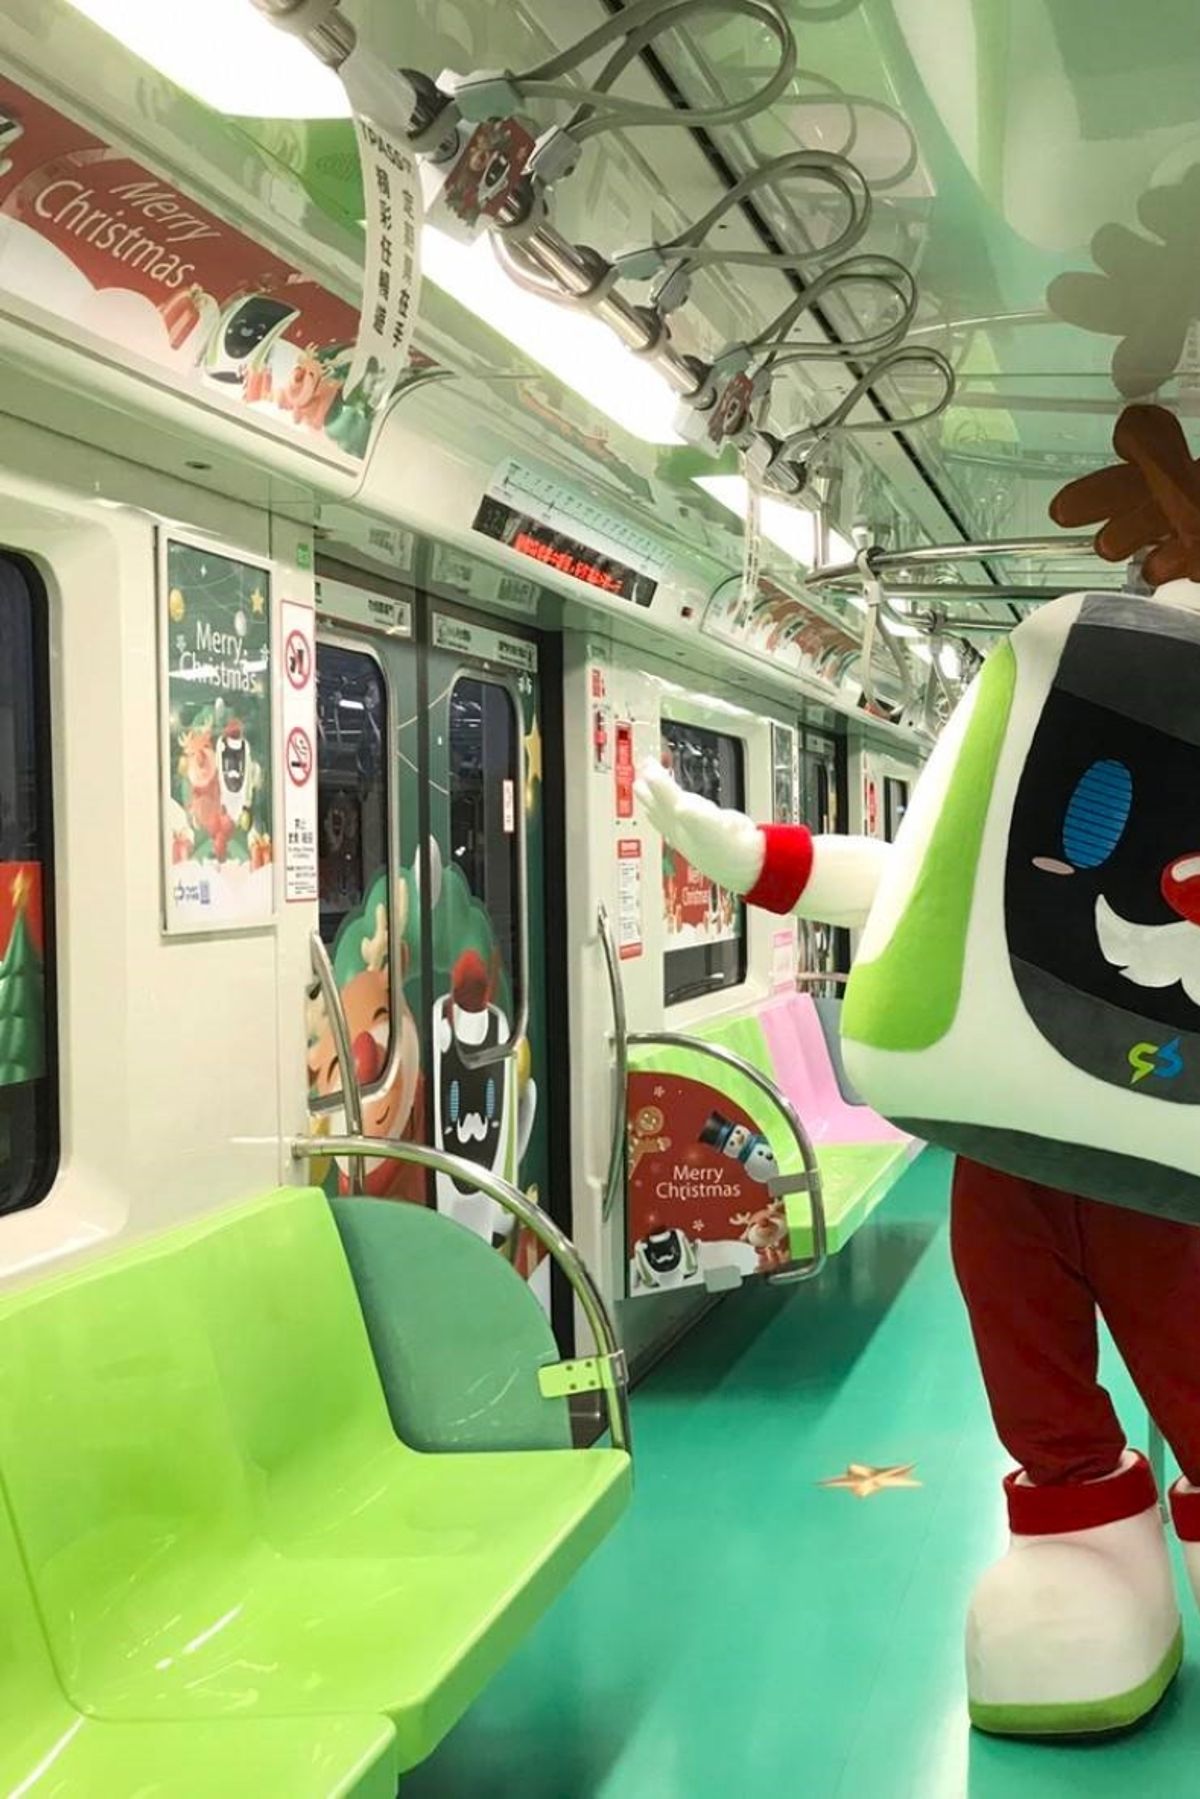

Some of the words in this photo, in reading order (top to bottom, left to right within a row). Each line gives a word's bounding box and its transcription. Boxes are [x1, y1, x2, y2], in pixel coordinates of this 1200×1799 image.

[109, 182, 221, 242] Merry
[35, 180, 195, 288] Christmas
[196, 620, 243, 665] Merry
[179, 651, 257, 692] Chistmas
[656, 1182, 741, 1200] Christmas
[673, 1165, 723, 1183] Merry
